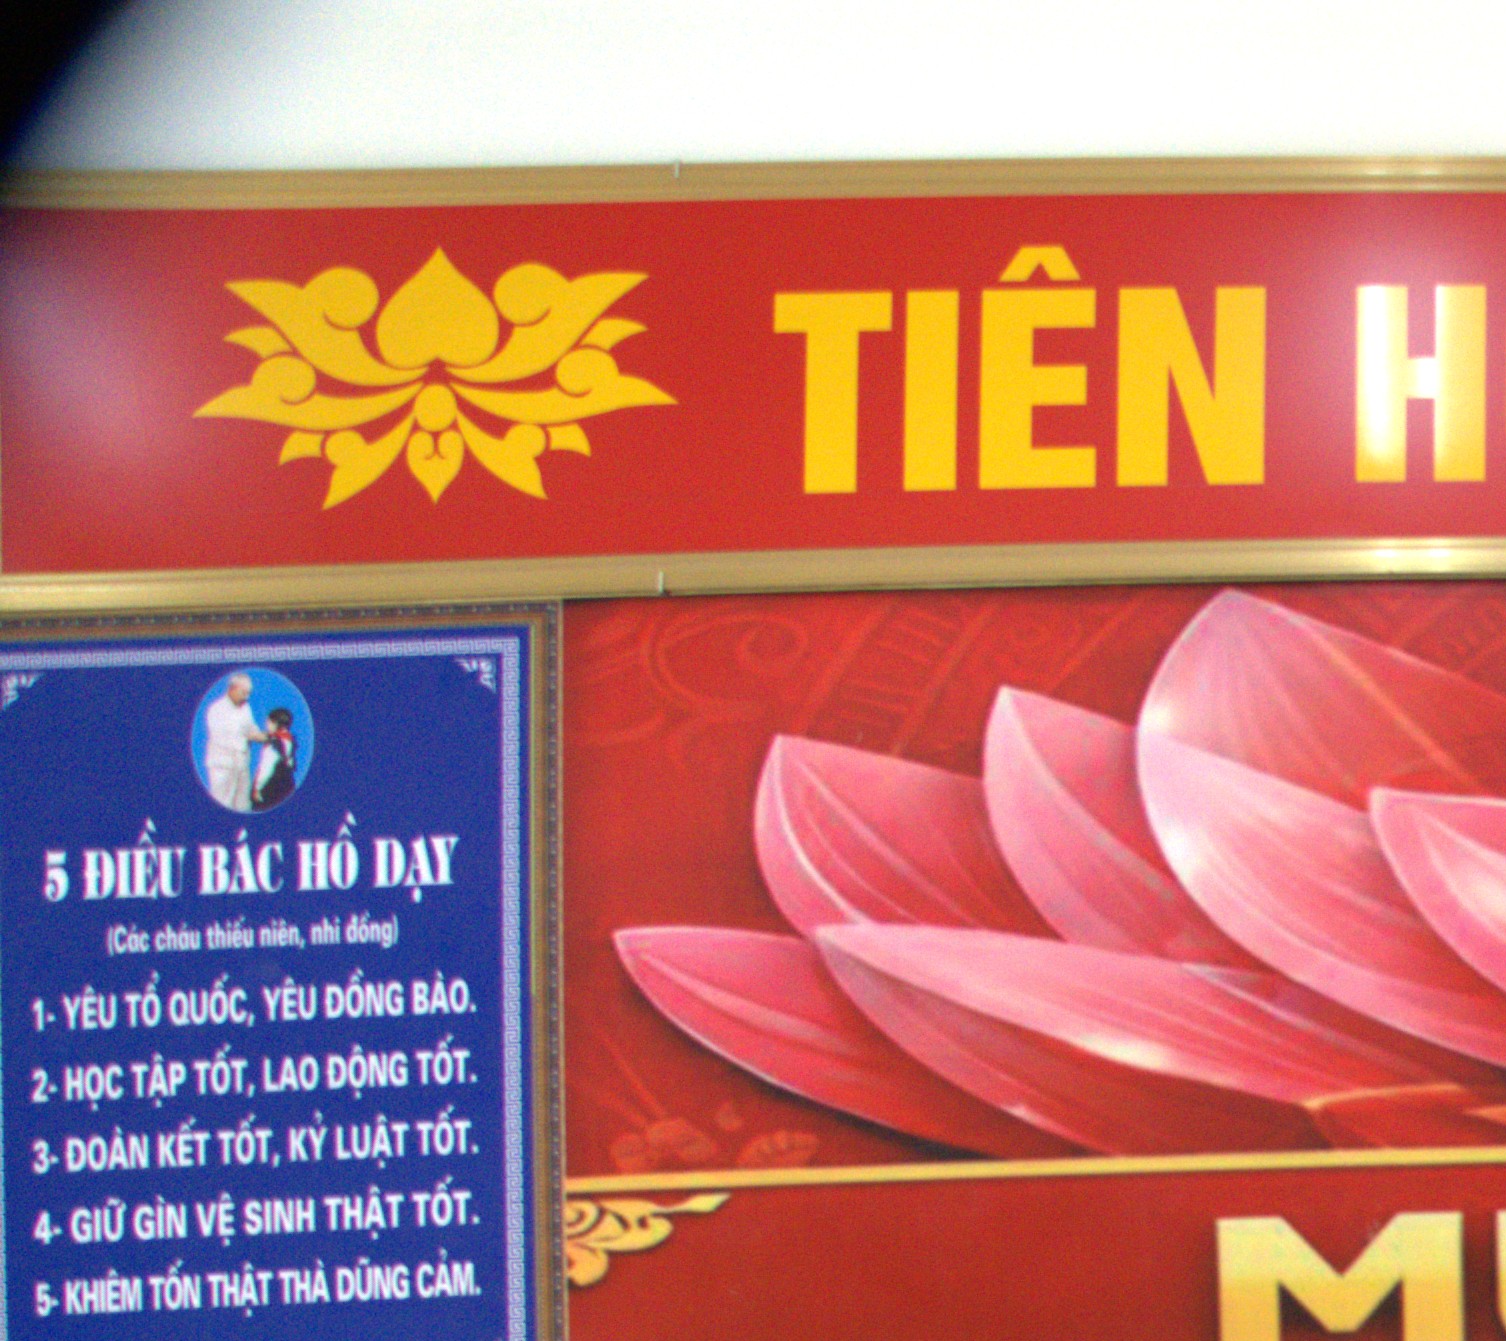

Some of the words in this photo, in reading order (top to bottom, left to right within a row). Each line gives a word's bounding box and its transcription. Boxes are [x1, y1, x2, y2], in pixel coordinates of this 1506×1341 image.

[773, 245, 1266, 495] TIÊN
[44, 850, 70, 901] 5
[83, 816, 186, 899] ĐIỀU
[199, 827, 284, 895] BÁC
[297, 812, 359, 891] HỒ
[372, 834, 460, 903] DẠY
[62, 985, 117, 1030] YÊU
[125, 970, 161, 1027] TỔ
[169, 974, 254, 1027] QUỐC,
[262, 975, 317, 1021] YÊU
[325, 967, 404, 1018] ĐỒNG
[411, 970, 476, 1014] BÀO.
[64, 1065, 124, 1111] HỌC
[131, 1052, 186, 1108] TẬP
[194, 1044, 254, 1097] TỐT,
[263, 1056, 319, 1092] LAO
[327, 1044, 408, 1099] ĐỘNG
[416, 1033, 477, 1084] TỐT.
[65, 1126, 149, 1172] ĐOÀN
[158, 1116, 211, 1167] KẾT
[218, 1113, 280, 1167] TỐT,
[287, 1110, 327, 1161] KỶ
[336, 1114, 409, 1169] LUẬT
[417, 1104, 479, 1155] TỐT.
[70, 1197, 126, 1242] GIỮ
[133, 1195, 187, 1240] GÌN
[196, 1191, 235, 1246] VỆ
[243, 1198, 316, 1235] SINH
[324, 1185, 404, 1240] THẬT
[412, 1175, 479, 1226] TỐT.
[64, 1268, 142, 1314] KHIÊM
[149, 1258, 201, 1310] TỐN
[208, 1262, 273, 1317] THẬT
[279, 1258, 330, 1304] THÀ
[337, 1257, 410, 1300] DŨNG
[417, 1247, 481, 1297] CẢM.
